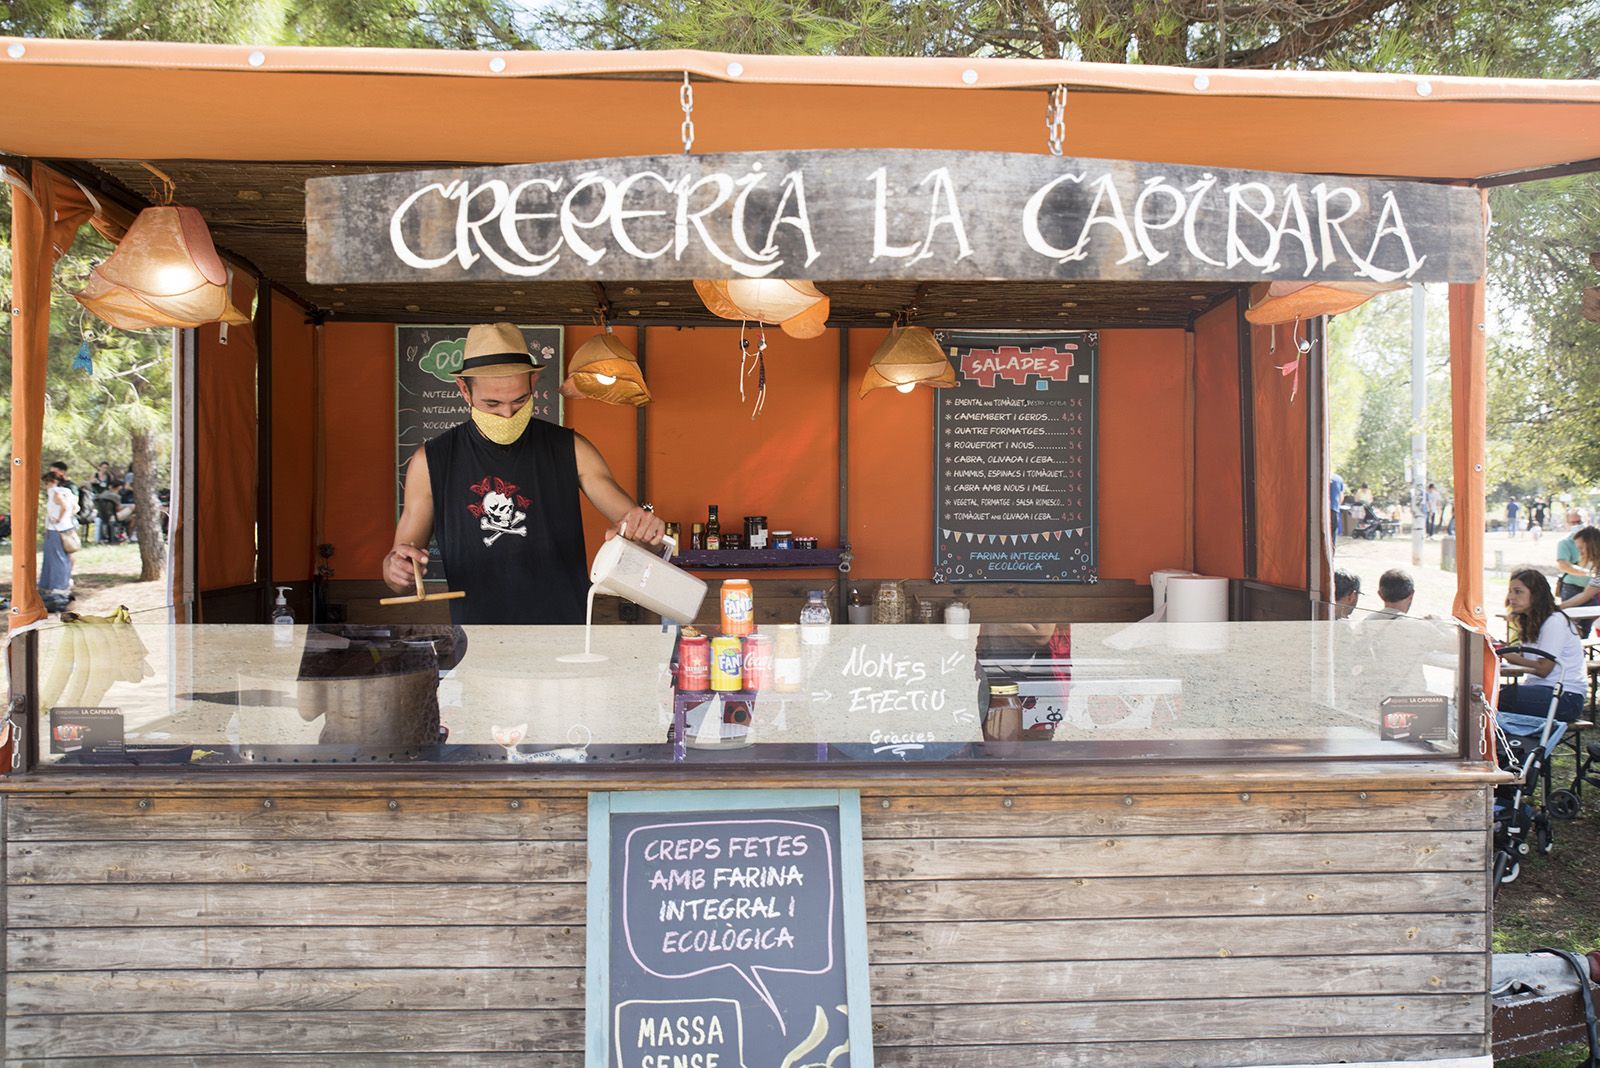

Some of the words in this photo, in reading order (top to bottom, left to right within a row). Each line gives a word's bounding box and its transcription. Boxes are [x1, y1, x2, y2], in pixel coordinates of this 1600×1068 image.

[390, 161, 822, 278] CREPERIA
[866, 166, 975, 267] LA
[1022, 170, 1428, 282] CAPIBARA
[971, 356, 1060, 375] SALADES
[422, 390, 463, 399] NUTELLA
[954, 398, 983, 407] EMENTAL
[422, 405, 457, 414] NUTELLA
[954, 413, 1011, 421] CAMEMBERT
[954, 427, 989, 435] QUATRE
[953, 441, 1004, 450] ROQUEFORT
[953, 455, 985, 464] CABRA,
[987, 455, 1024, 463] OLIVADA
[953, 469, 986, 478] HUMMUS,
[987, 469, 1022, 478] ESPINACS
[953, 484, 980, 492] CABRA
[982, 484, 1001, 492] AMB
[1003, 484, 1025, 492] NOUS
[1016, 498, 1034, 506] SALSA
[1002, 512, 1030, 521] OLIVADA
[969, 551, 1008, 561] FARINA
[1010, 551, 1061, 561] INTEGRAL
[987, 561, 1043, 571] ECOLÒGICA
[644, 837, 721, 862] CREPS
[728, 834, 809, 859] FETES
[648, 868, 707, 892] AMB
[713, 865, 805, 890] FARINA
[658, 896, 782, 922] INTEGRAL
[787, 896, 796, 918] I
[662, 922, 795, 953] ECOLÒGICA
[637, 1015, 724, 1049] MASSA
